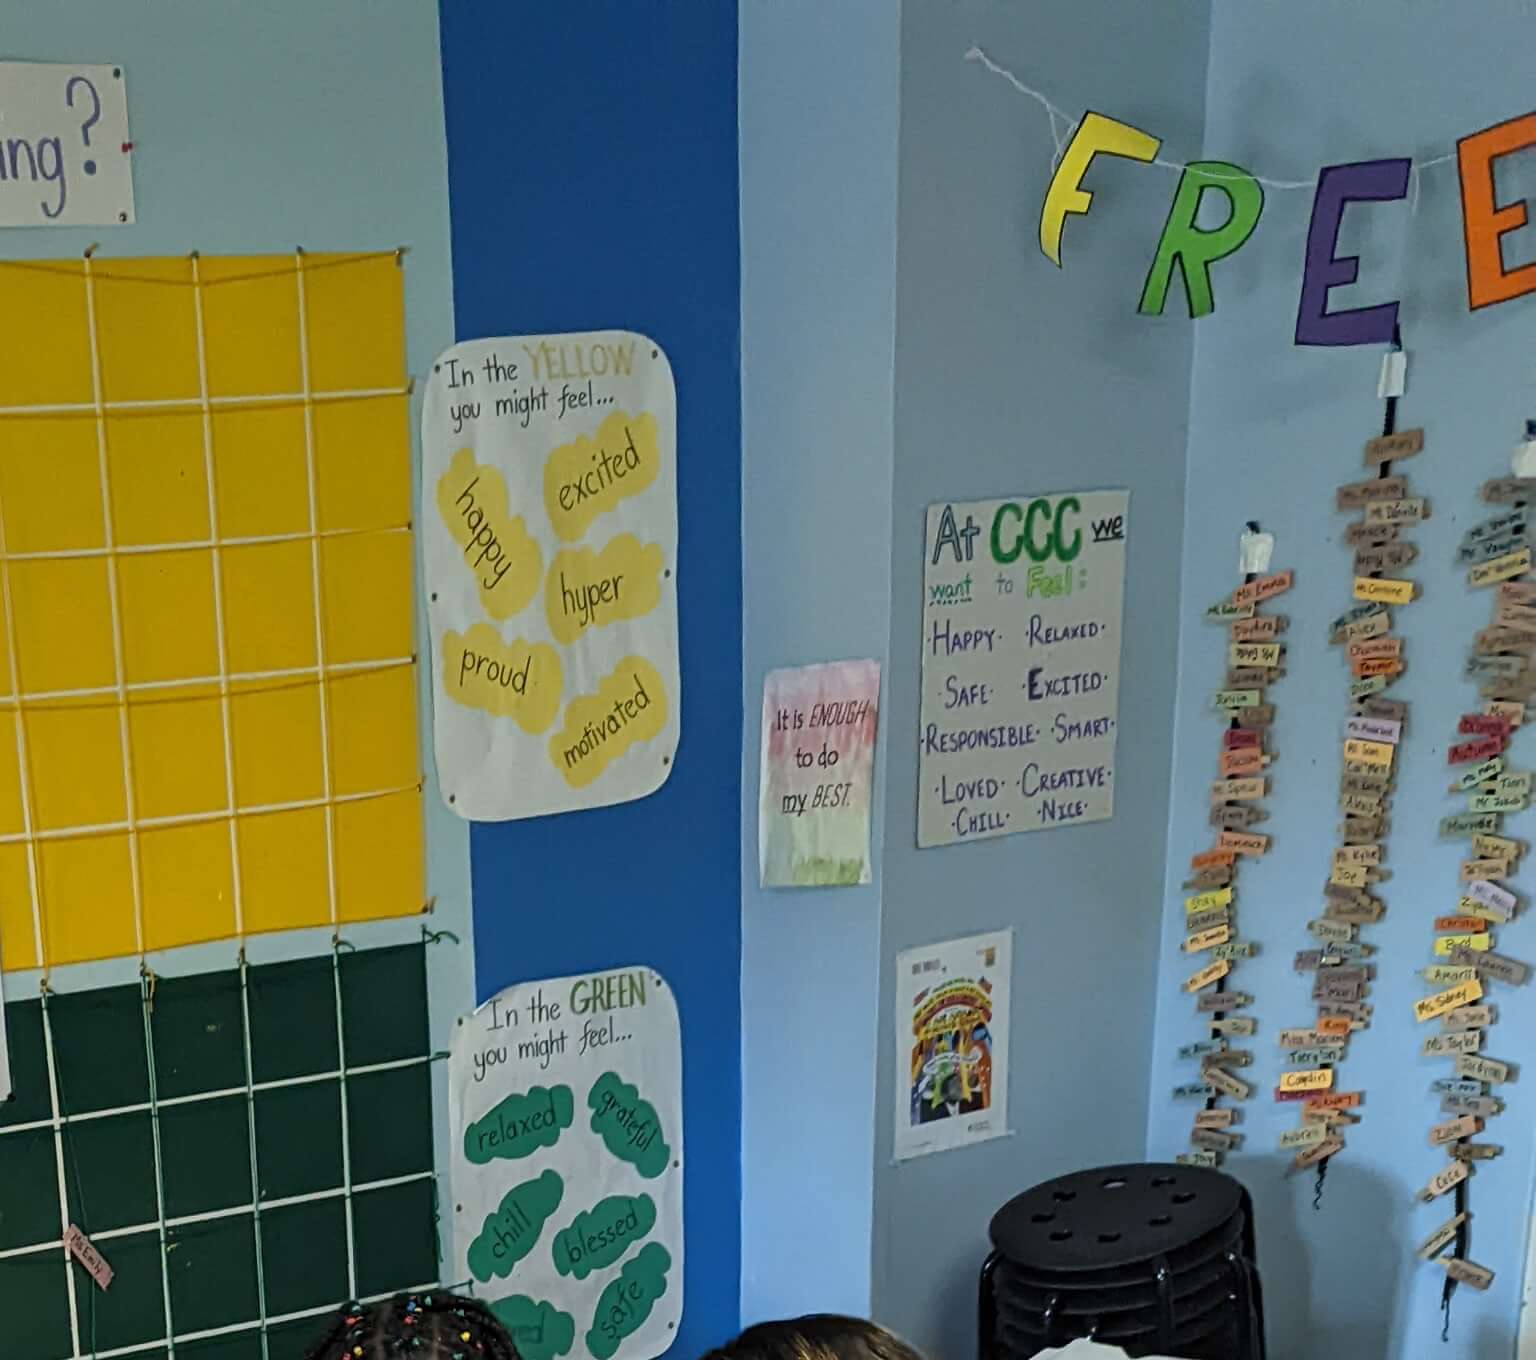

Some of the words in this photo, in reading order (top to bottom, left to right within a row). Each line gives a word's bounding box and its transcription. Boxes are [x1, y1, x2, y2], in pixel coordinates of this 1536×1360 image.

[445, 359, 474, 388] In
[483, 354, 517, 382] the
[522, 340, 638, 379] YELLOW
[450, 402, 480, 433] you
[496, 387, 549, 427] might
[557, 381, 614, 420] feel...
[559, 427, 641, 511] excited
[456, 477, 511, 590] happy
[933, 504, 980, 564] At
[991, 497, 1081, 563] CCC
[1091, 516, 1124, 542] we
[561, 573, 623, 626] hyper
[930, 573, 972, 600] want
[995, 574, 1013, 594] to
[461, 649, 531, 695] proud
[565, 675, 650, 767] motivated
[777, 710, 788, 730] It
[793, 710, 803, 729] is
[809, 700, 869, 728] ENOUGH
[795, 748, 813, 768] to
[817, 743, 839, 768] do
[782, 793, 806, 816] my
[487, 1000, 518, 1032] In
[527, 990, 560, 1024] the
[570, 971, 646, 1015] GREEN
[474, 1045, 507, 1082] you
[519, 1029, 566, 1069] might
[579, 1016, 632, 1056] feel...
[478, 1093, 557, 1152] relaxed
[601, 1089, 657, 1153] grateful
[492, 1203, 531, 1260] chill
[566, 1207, 638, 1264] blessed
[601, 1278, 643, 1339] safe
